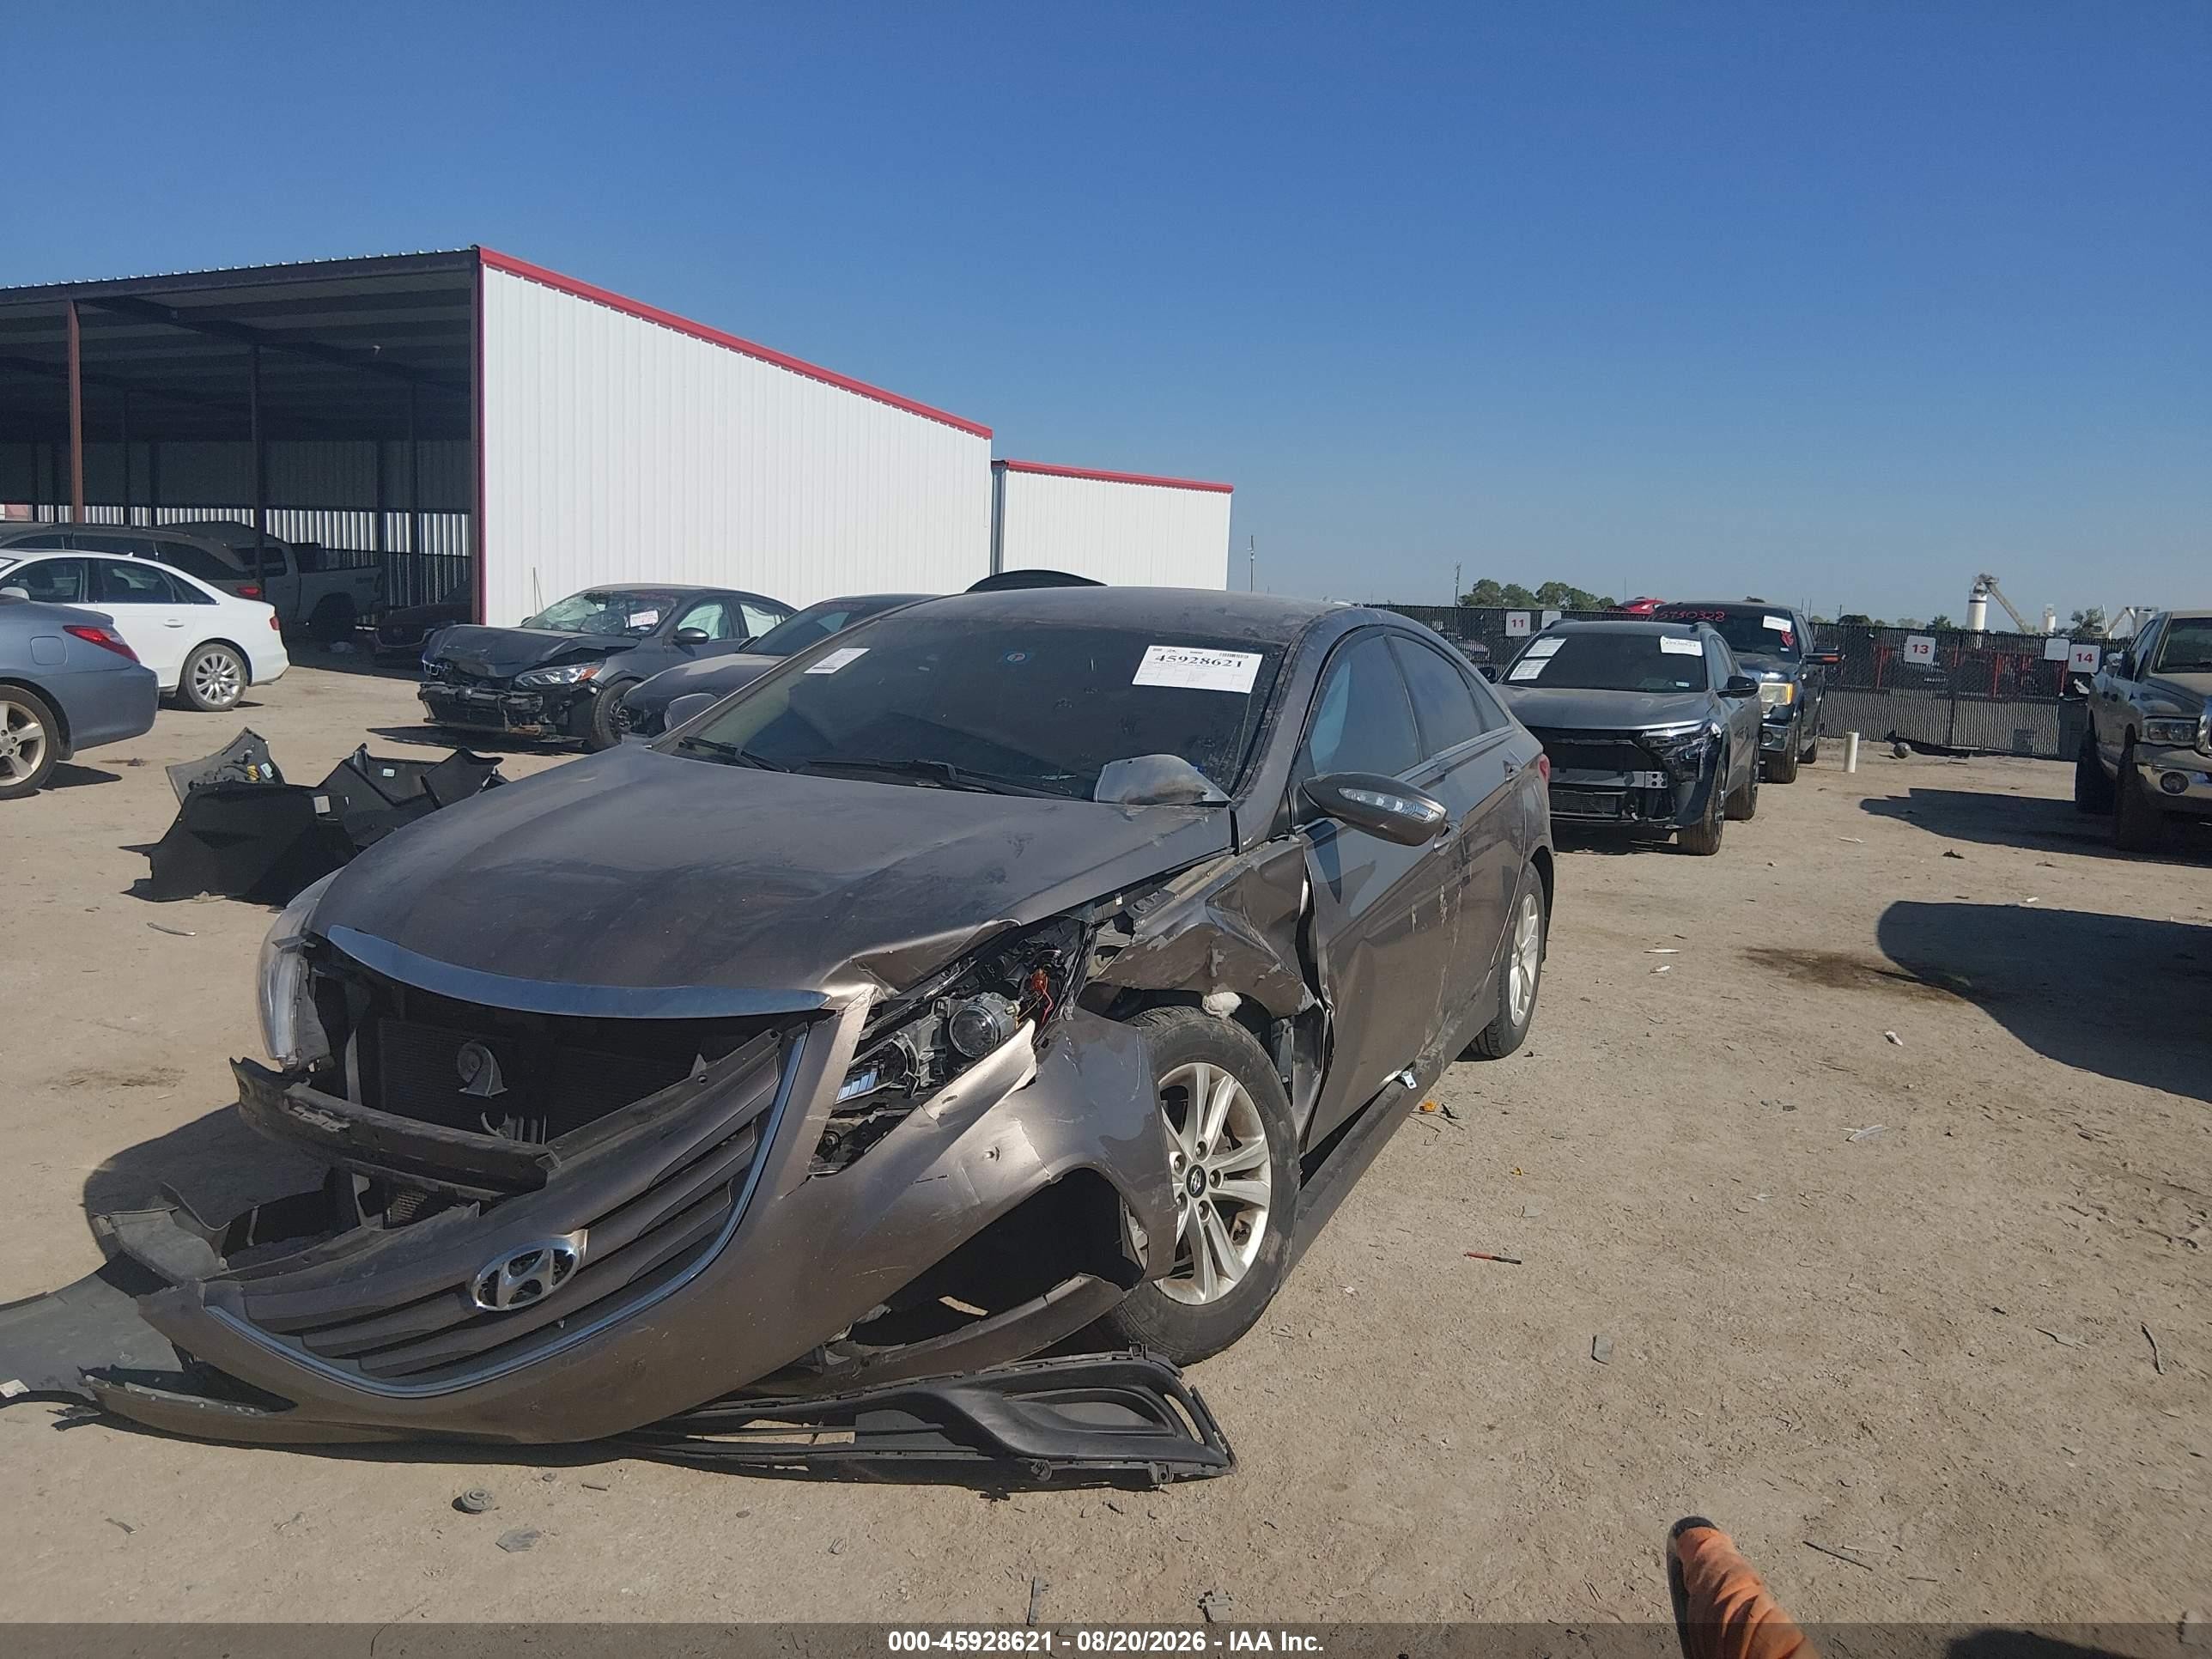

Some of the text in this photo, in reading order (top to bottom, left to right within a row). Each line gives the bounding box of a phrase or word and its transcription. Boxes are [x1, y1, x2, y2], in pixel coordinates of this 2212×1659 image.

[1511, 618, 1524, 628] 11
[1912, 644, 1929, 654] 13
[1155, 654, 1243, 668] 45928621
[2076, 653, 2094, 663] 14
